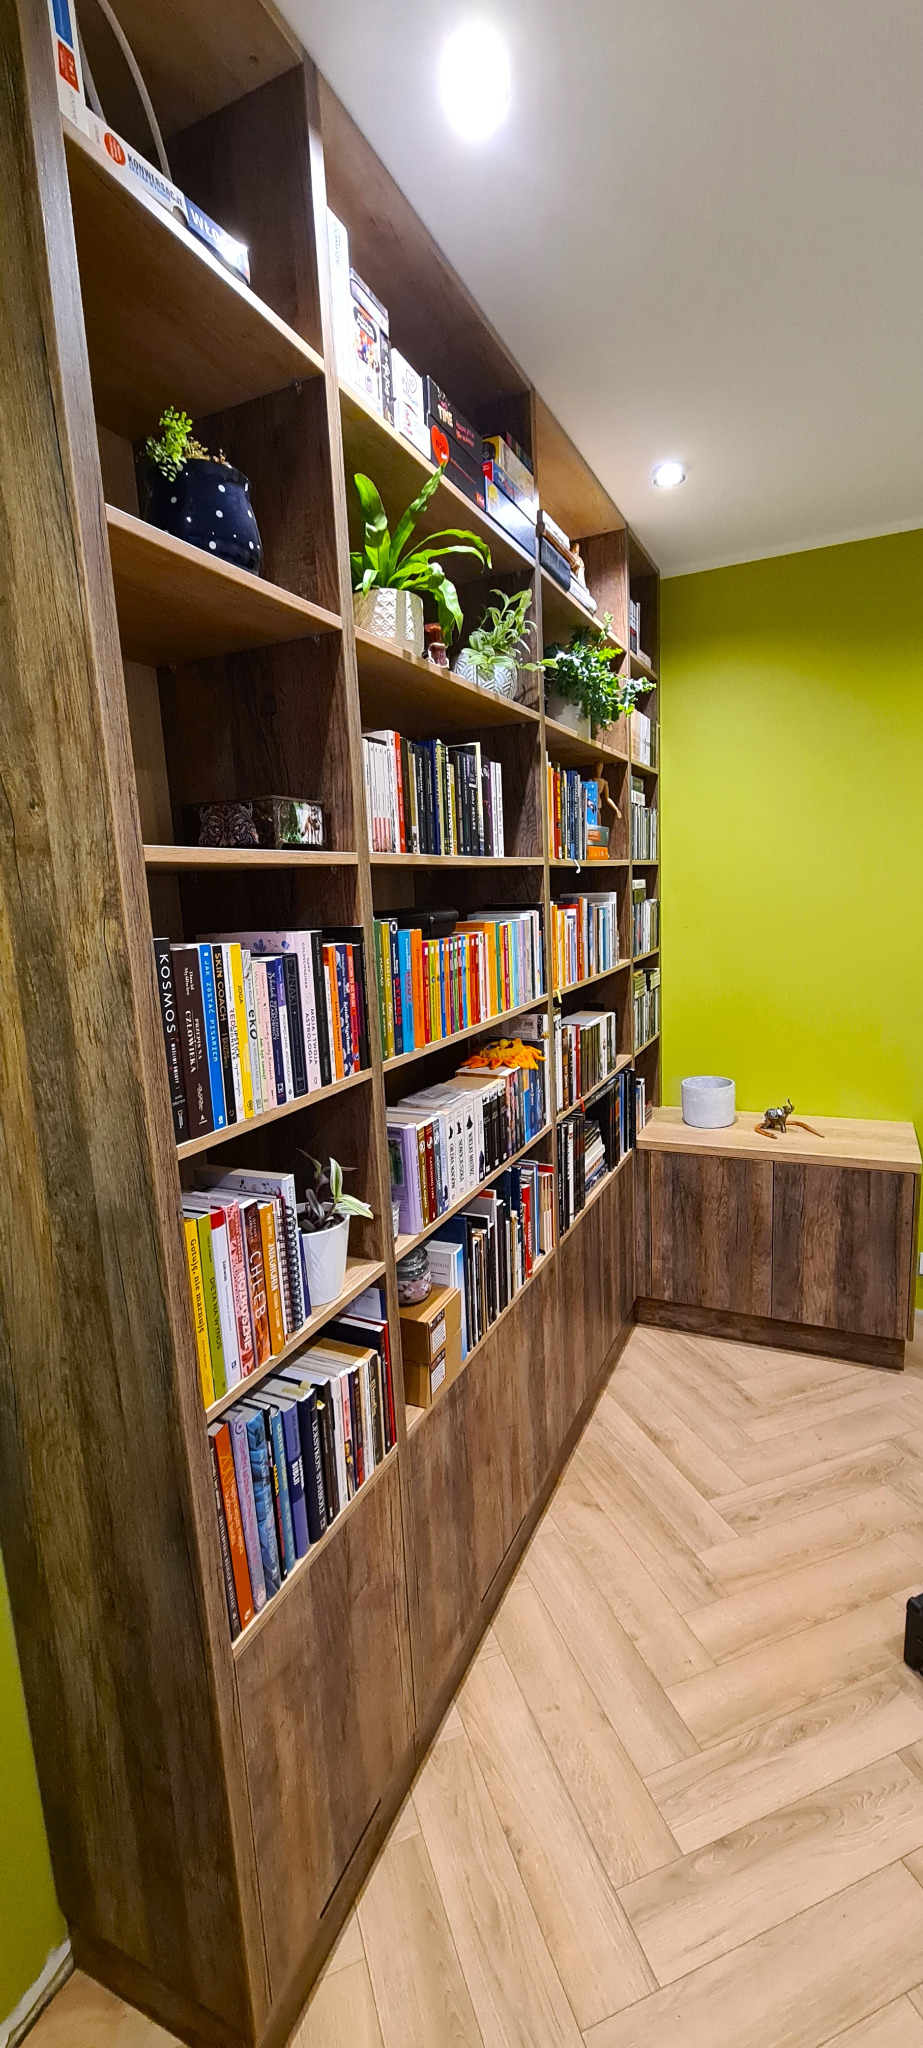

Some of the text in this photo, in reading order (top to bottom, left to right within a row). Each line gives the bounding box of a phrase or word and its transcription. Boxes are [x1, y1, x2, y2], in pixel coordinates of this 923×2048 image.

[127, 154, 184, 208] KONWERSACJE
[437, 404, 454, 428] TIME
[159, 954, 176, 1033] KOSMOS
[206, 983, 215, 1014] ZOSTAĆ
[217, 981, 227, 1022] COACH
[185, 1011, 197, 1073] CZŁOWIEKA
[198, 1050, 203, 1060] NA
[209, 1020, 218, 1062] PISARZEM
[305, 1013, 313, 1065] ASTROLOGIA
[190, 1238, 199, 1274] Gotuję,
[195, 1293, 204, 1334] marnuję
[237, 1270, 252, 1350] ROZKOSZNE
[249, 1251, 266, 1319] CHLEB
[209, 1277, 222, 1350] DIETA NA WYNOS
[220, 1455, 235, 1485] 200
[291, 1460, 300, 1486] BIBLII
[311, 1420, 326, 1515] LEKSYKON SYMBOLI
[219, 1515, 228, 1556] ENCYKLOPEDIA
[227, 1583, 236, 1609] ZWIERZĄT
